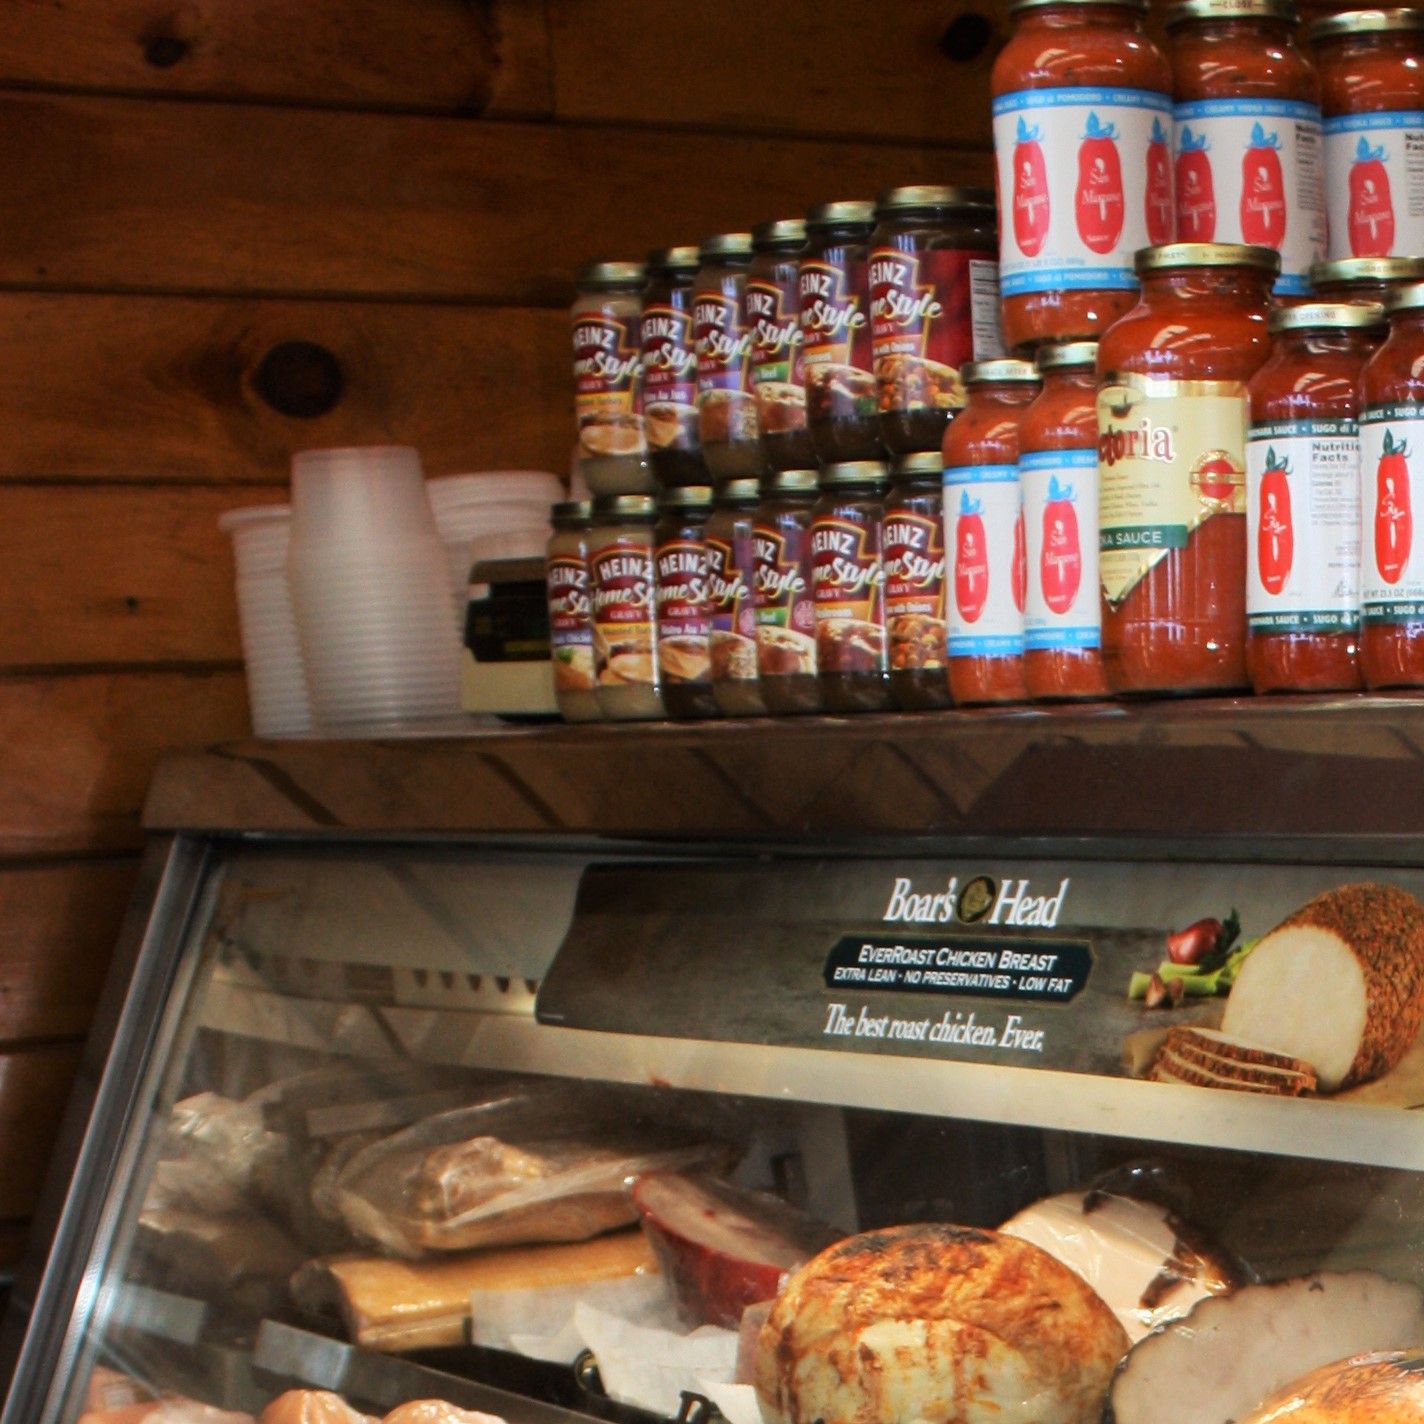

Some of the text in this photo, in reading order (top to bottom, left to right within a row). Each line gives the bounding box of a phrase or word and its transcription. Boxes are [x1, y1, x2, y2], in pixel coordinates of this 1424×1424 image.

[883, 877, 1070, 928] Boar's Head
[936, 947, 998, 970] CHICKEN
[999, 949, 1058, 973] BREAST
[833, 967, 1073, 994] EXTRA LEAN NO PRESERVATIVES LOW FAT
[823, 1003, 1045, 1052] The best roast chicken. Ever.
